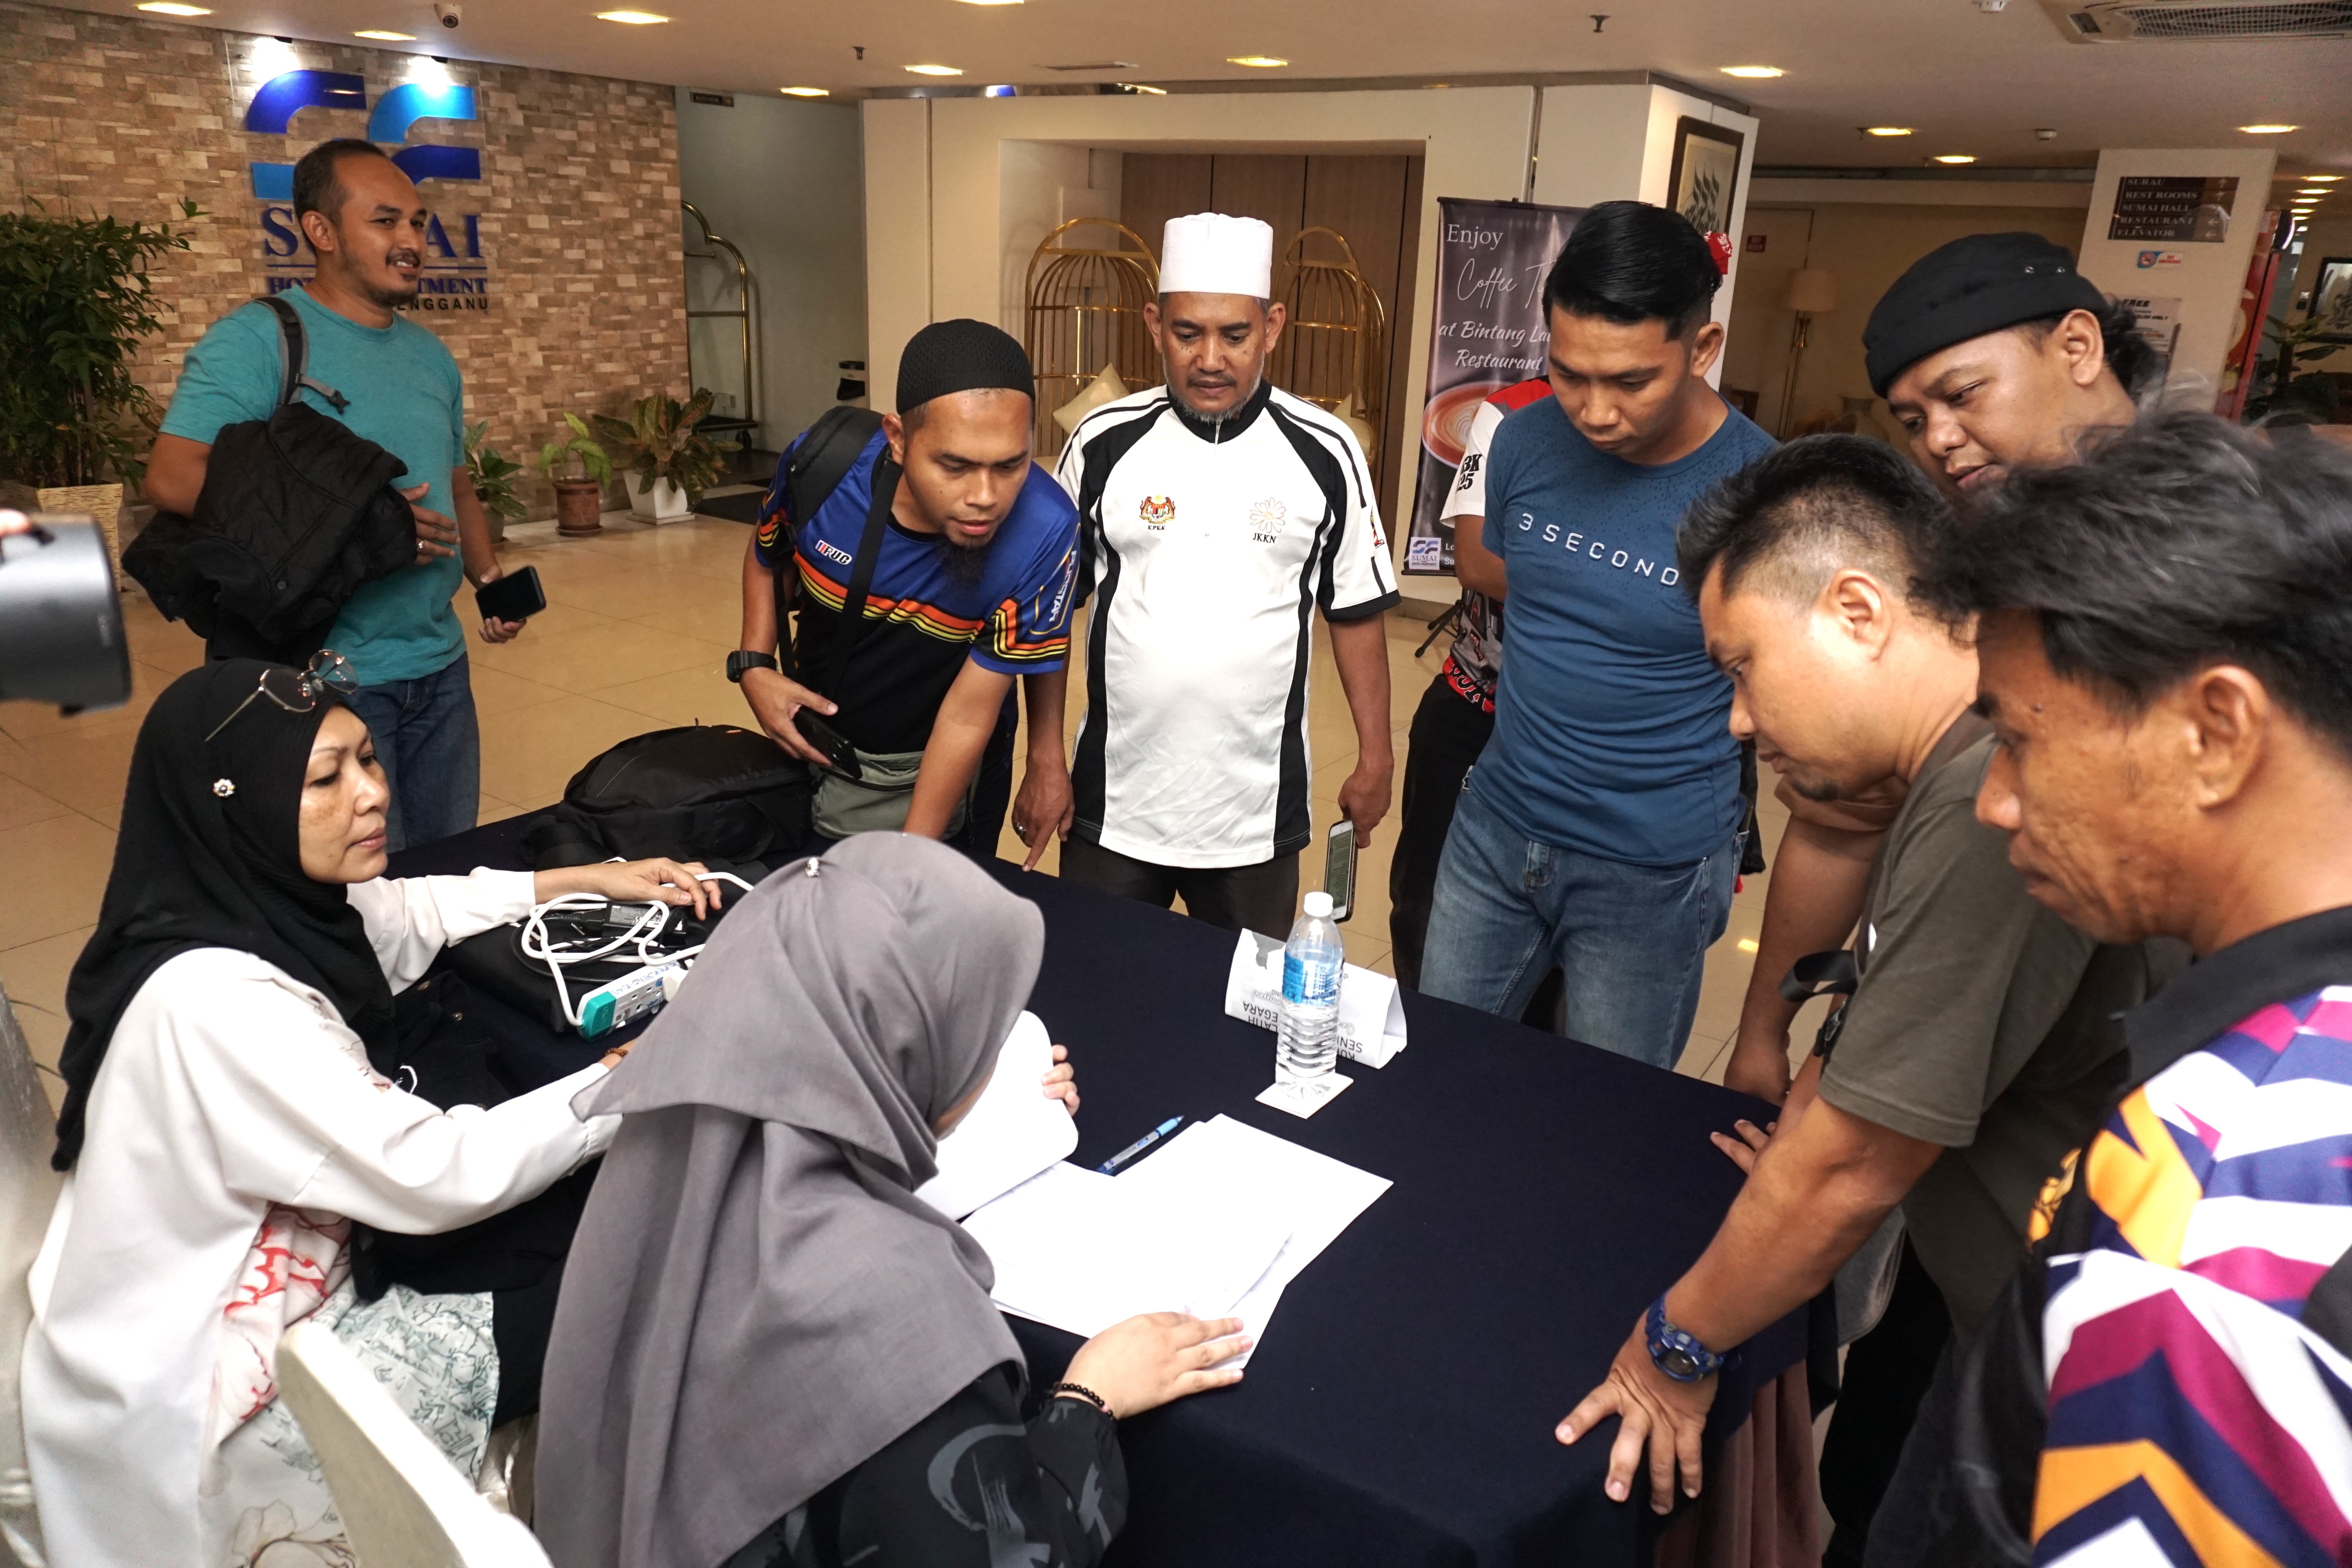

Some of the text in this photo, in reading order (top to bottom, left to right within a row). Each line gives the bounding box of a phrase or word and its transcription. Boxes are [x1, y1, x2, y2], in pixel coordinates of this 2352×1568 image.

[1446, 224, 1504, 250] Enjoy
[1457, 258, 1517, 309] Coffee
[1439, 323, 1457, 336] at
[1461, 321, 1526, 347] Bintang
[1455, 349, 1543, 370] Restaurant
[1252, 532, 1277, 544] JKKN
[1243, 1001, 1278, 1022] EGARA
